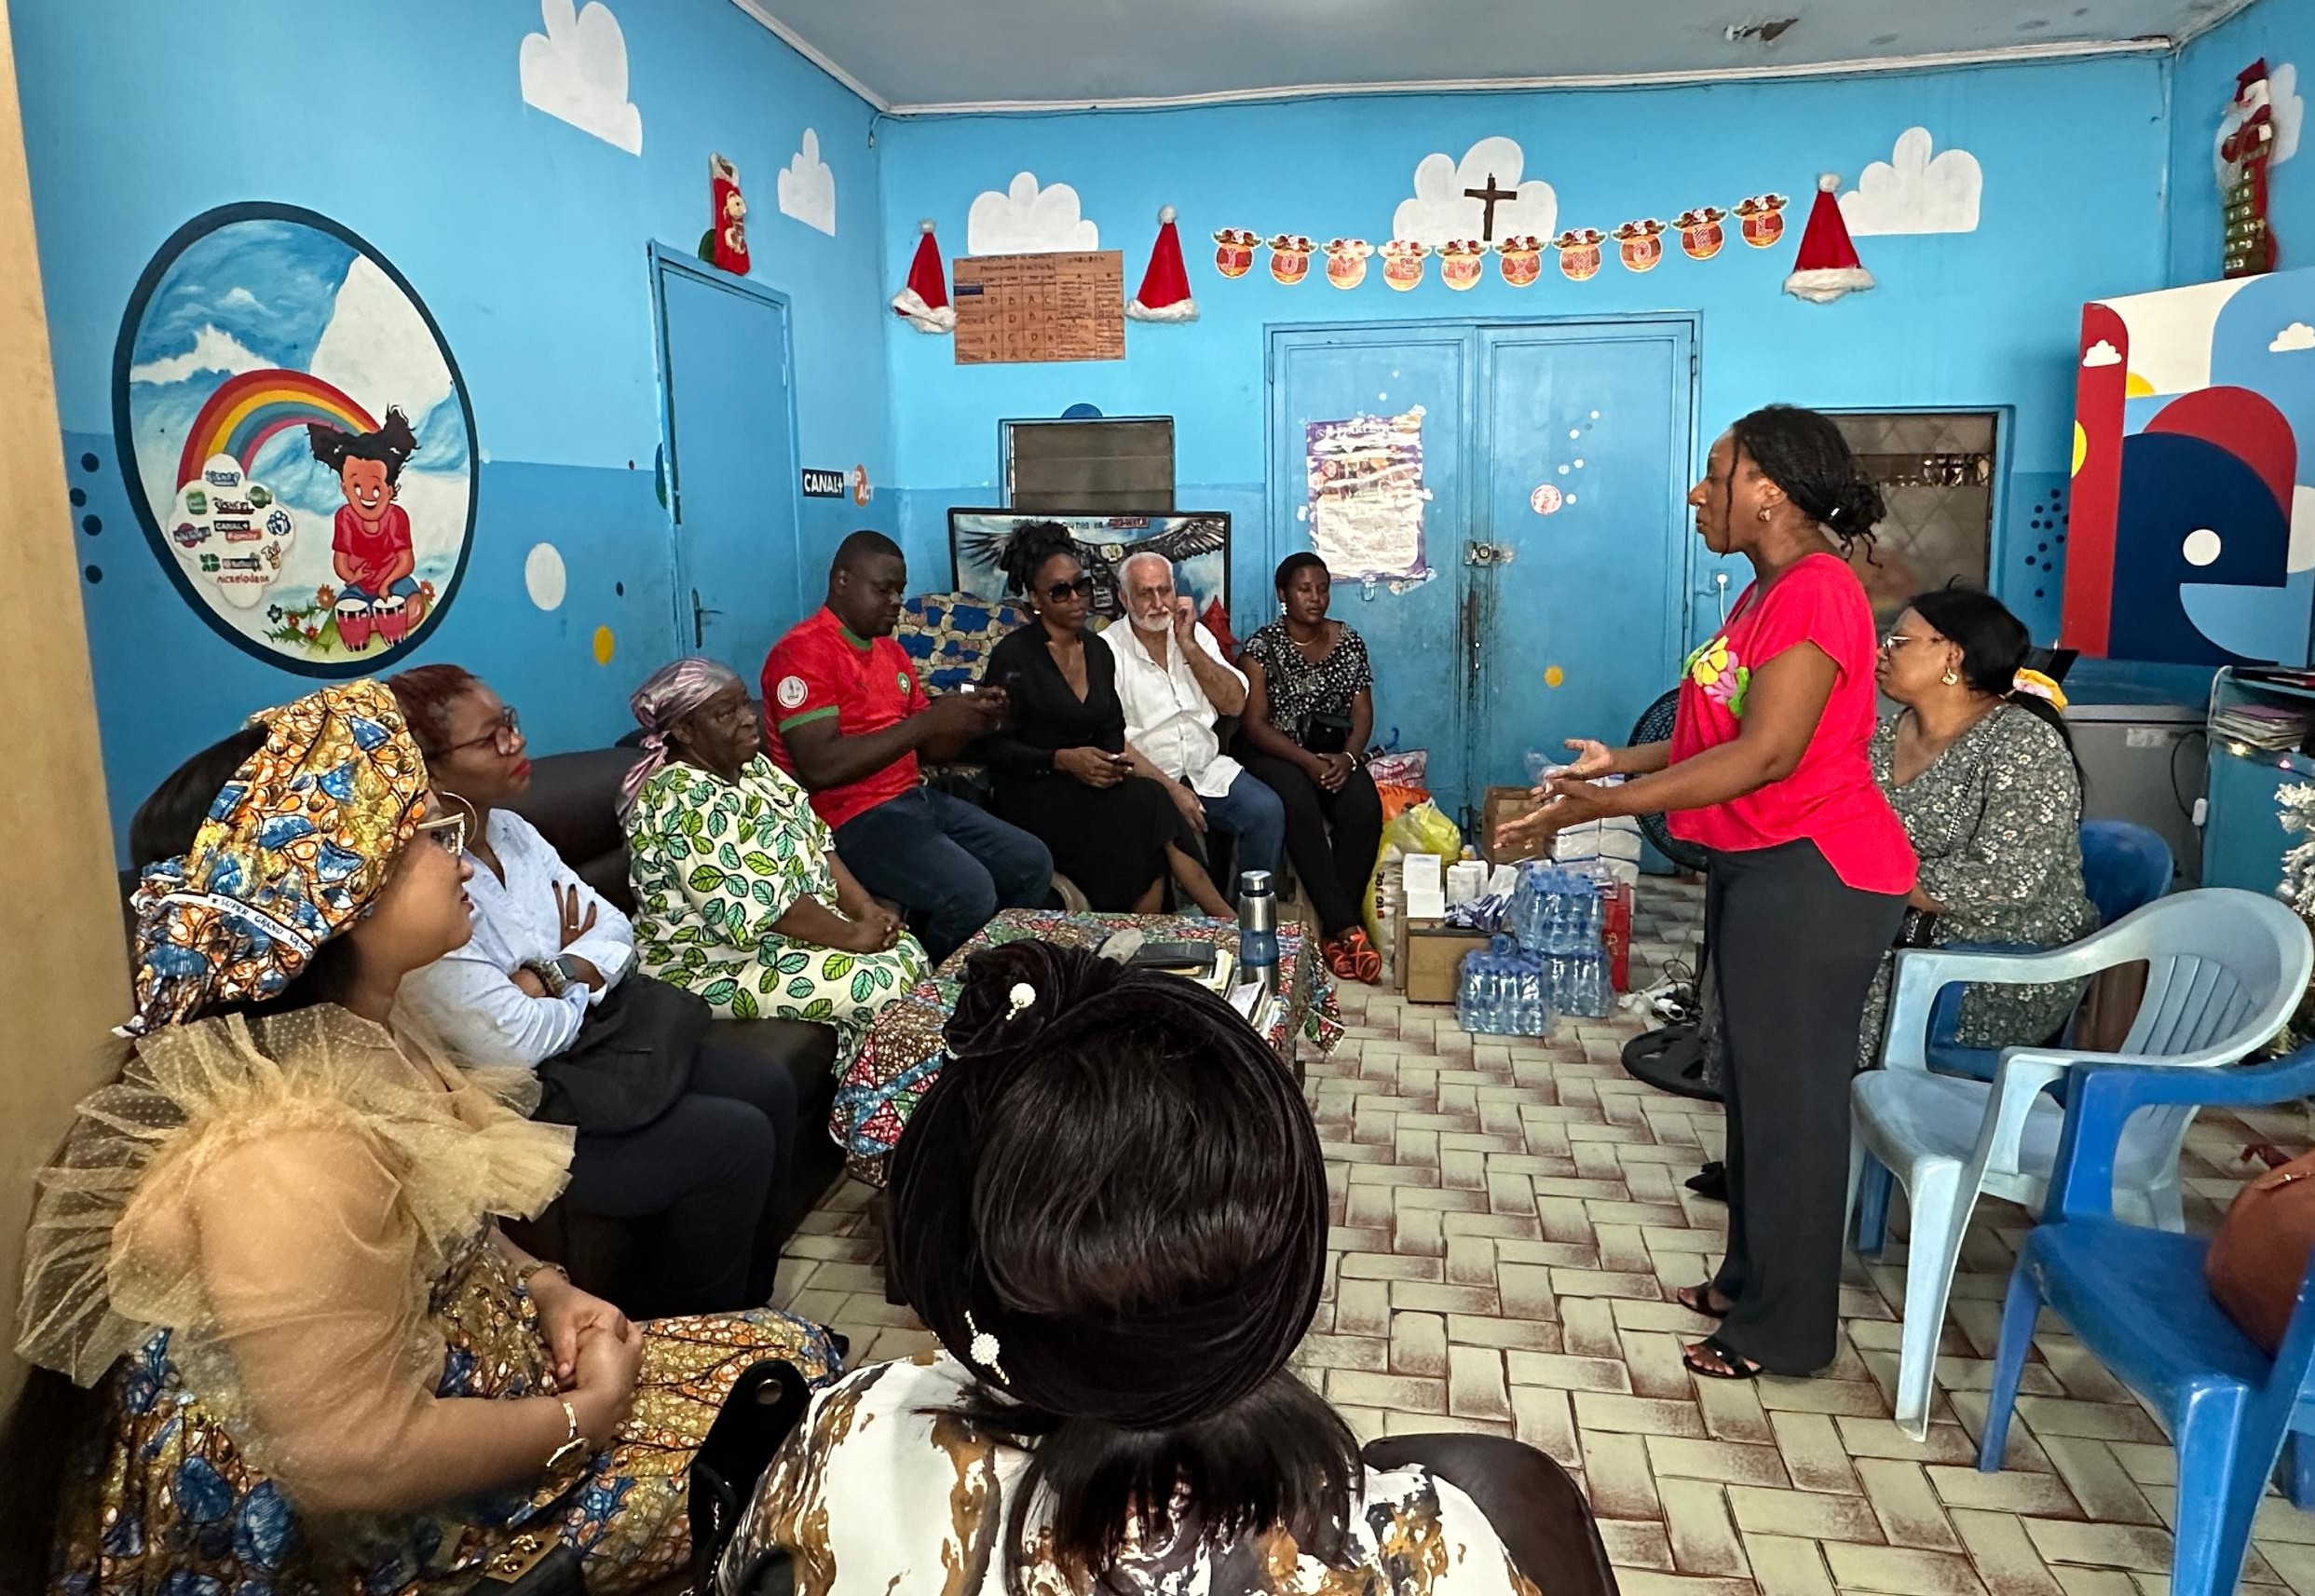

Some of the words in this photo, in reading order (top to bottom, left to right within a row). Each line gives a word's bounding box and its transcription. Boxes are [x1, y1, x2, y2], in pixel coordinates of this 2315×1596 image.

[804, 473, 843, 494] CANAL+
[220, 898, 250, 916] SUPER
[253, 915, 284, 934] GRAND
